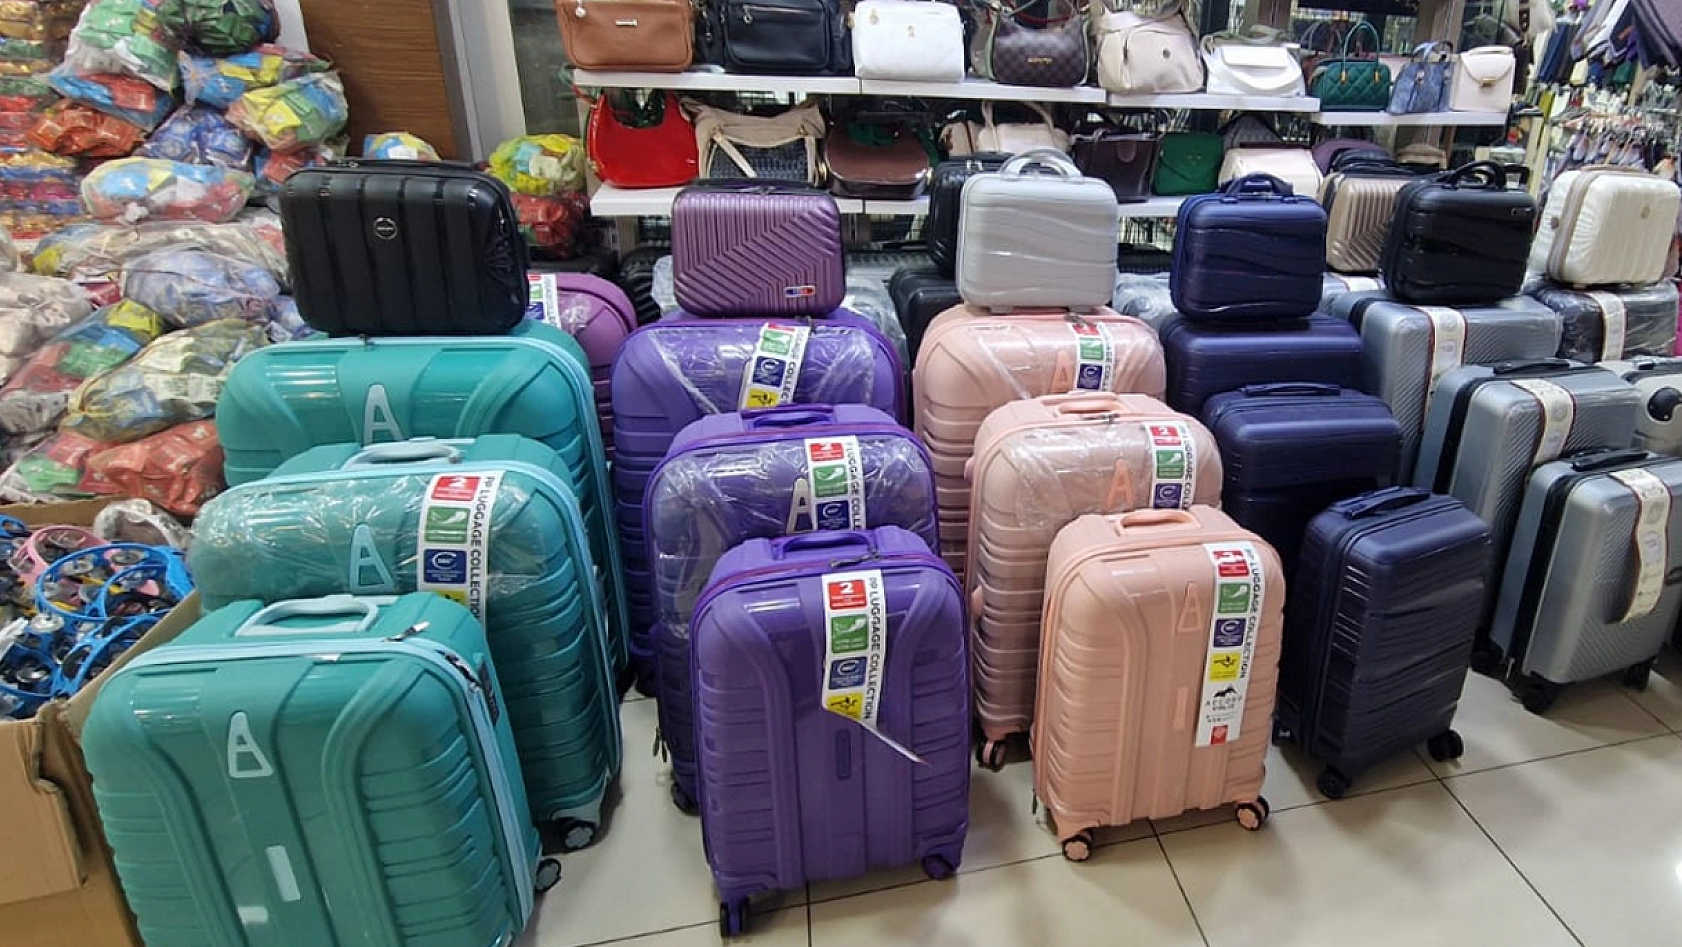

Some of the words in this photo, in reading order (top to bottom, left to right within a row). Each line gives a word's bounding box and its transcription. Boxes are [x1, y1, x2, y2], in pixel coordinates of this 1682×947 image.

[470, 490, 490, 547] LUGGAGE
[469, 550, 483, 618] COLLECTIO
[839, 582, 854, 594] 2
[869, 590, 881, 651] LUGGAGE
[864, 653, 881, 720] COLLECTION
[228, 711, 275, 778] A
